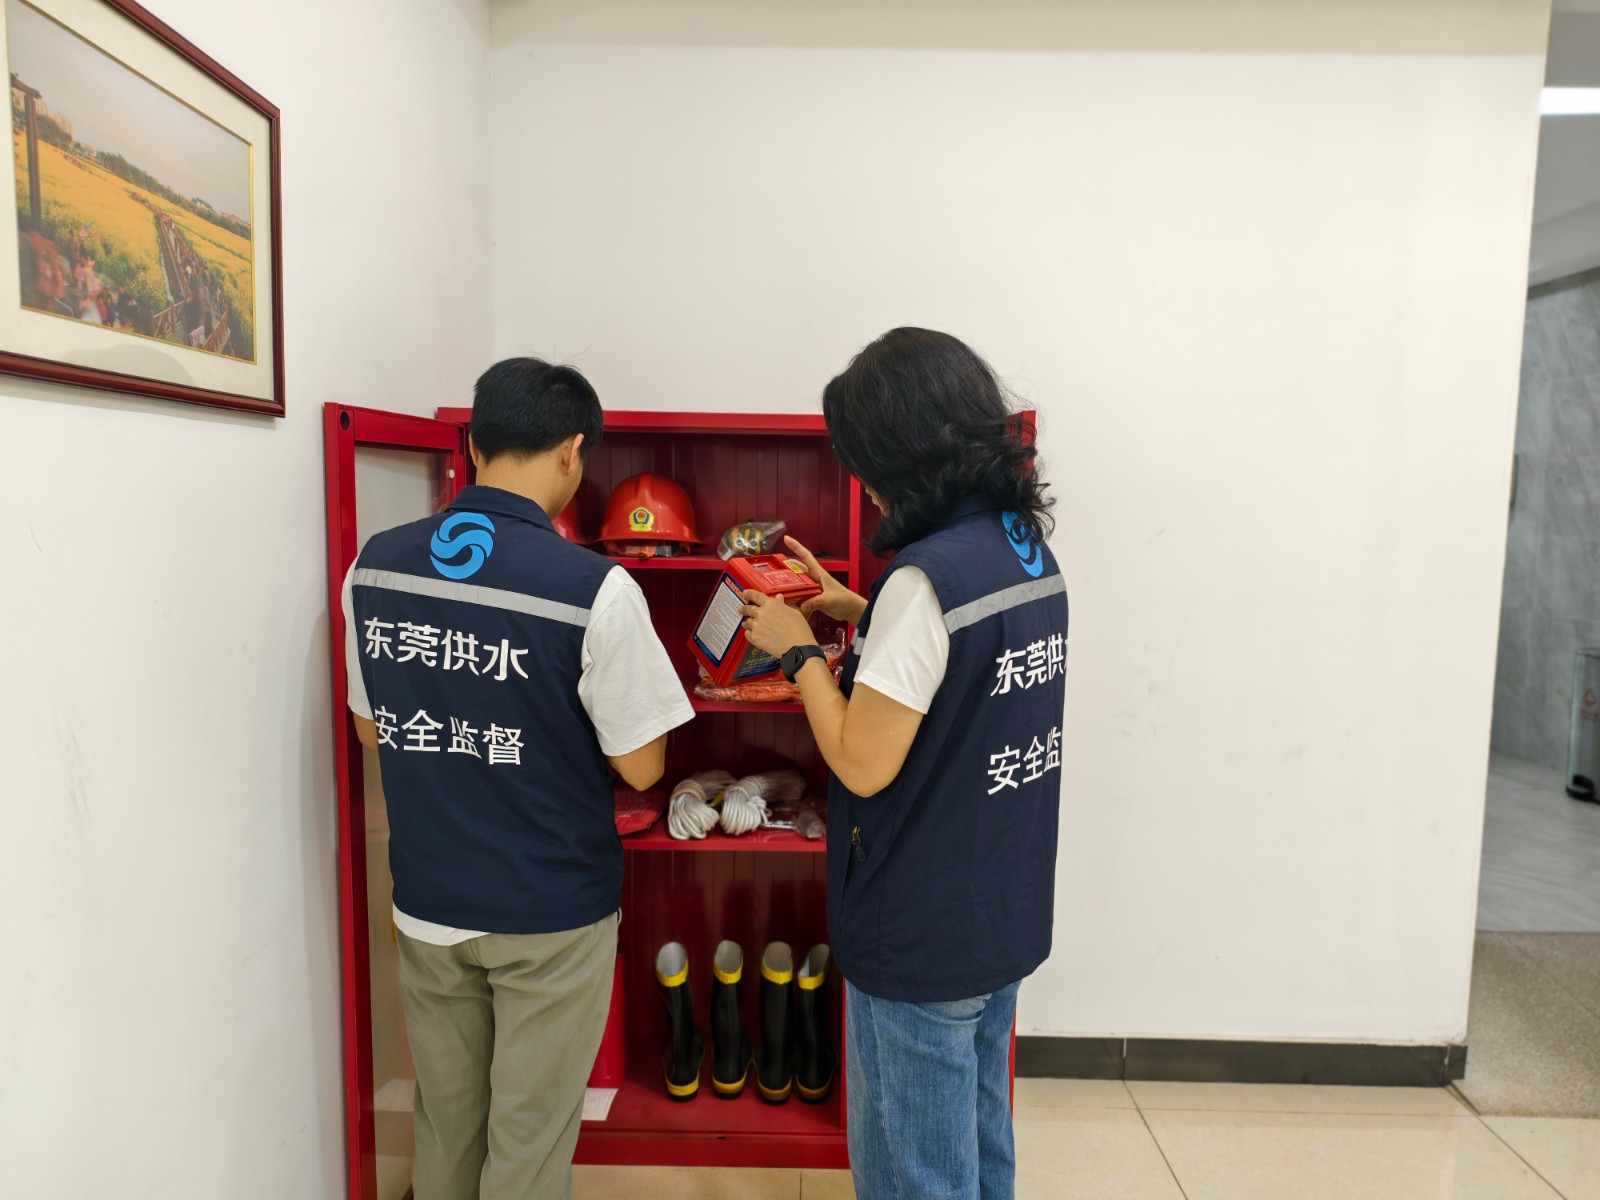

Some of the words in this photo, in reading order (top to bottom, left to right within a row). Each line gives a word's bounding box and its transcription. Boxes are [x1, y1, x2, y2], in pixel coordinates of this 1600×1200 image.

[364, 616, 529, 681] 东莞供水
[990, 632, 1068, 697] 东莞供
[374, 705, 525, 765] 安全监督
